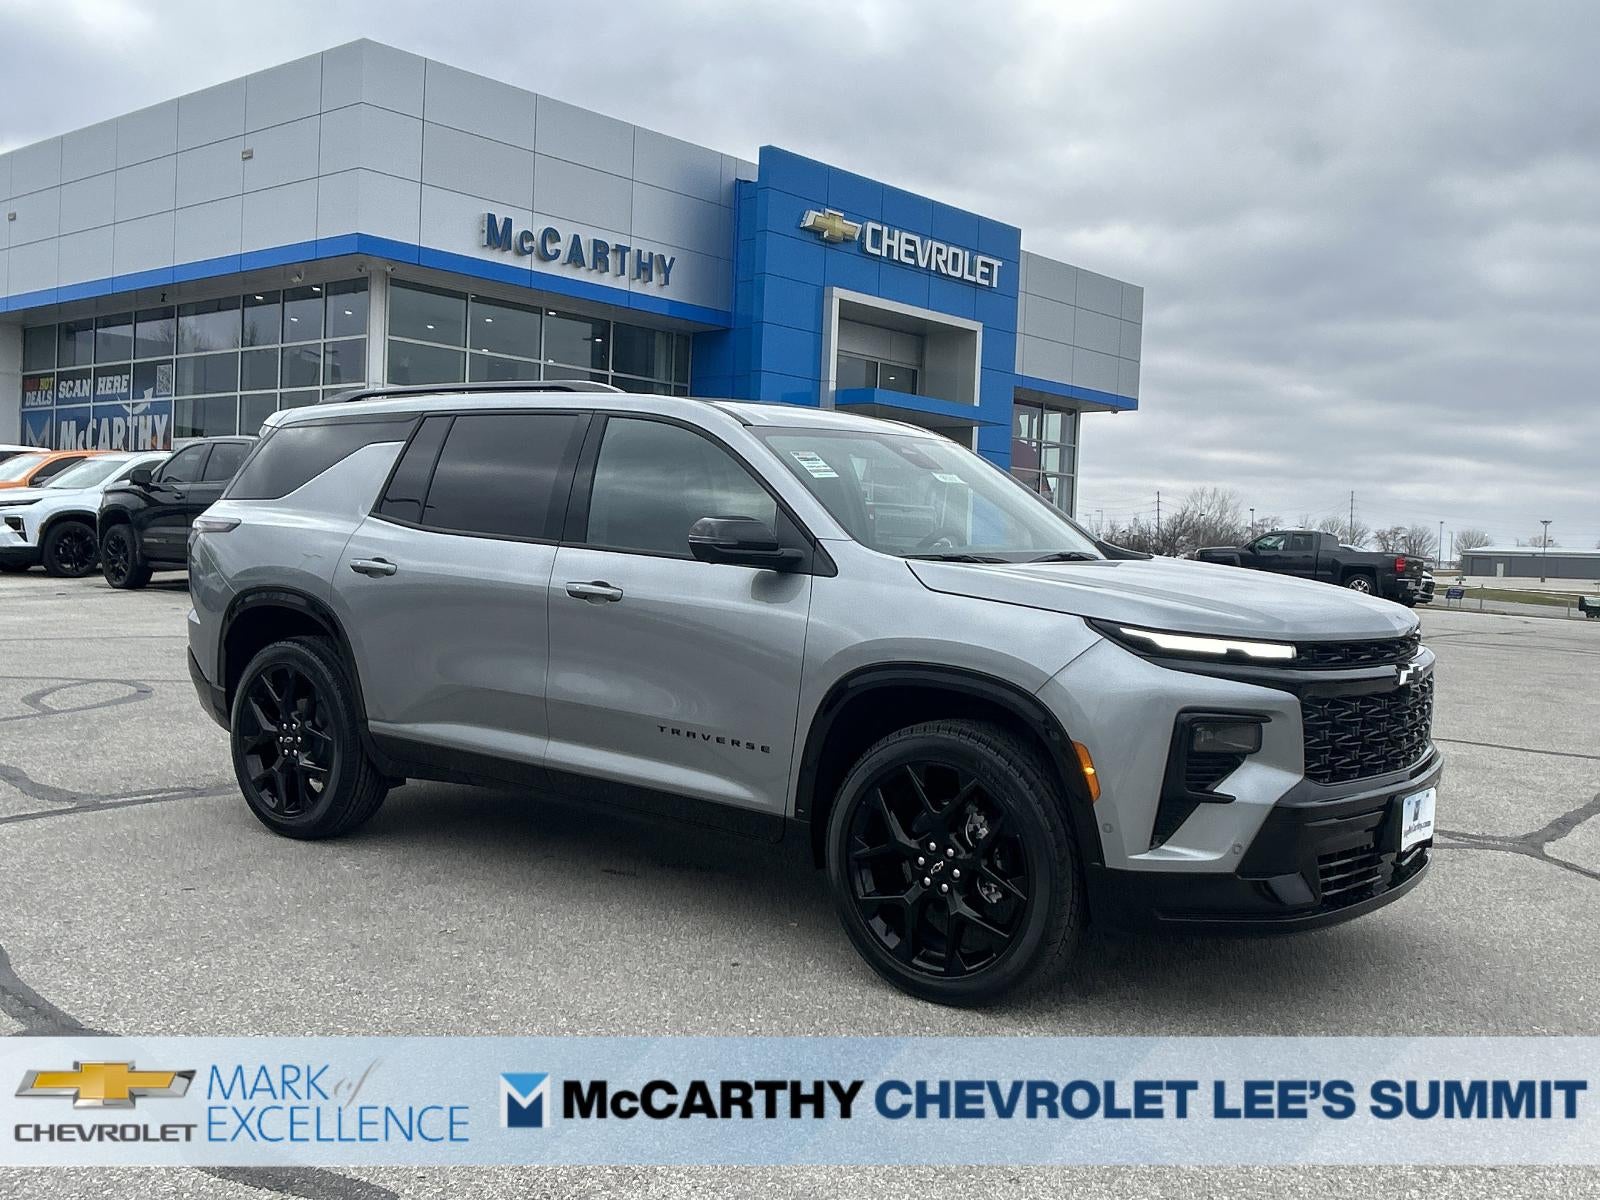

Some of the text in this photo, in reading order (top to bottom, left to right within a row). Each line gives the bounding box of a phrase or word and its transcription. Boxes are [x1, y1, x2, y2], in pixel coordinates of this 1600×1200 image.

[480, 212, 676, 287] McCARTHY
[864, 221, 1003, 288] CHEVROLET
[25, 390, 53, 406] DEALS
[58, 379, 91, 399] SCAN
[96, 374, 130, 395] HERE
[59, 414, 168, 450] McCARTHY
[657, 725, 771, 753] TRAVERSE
